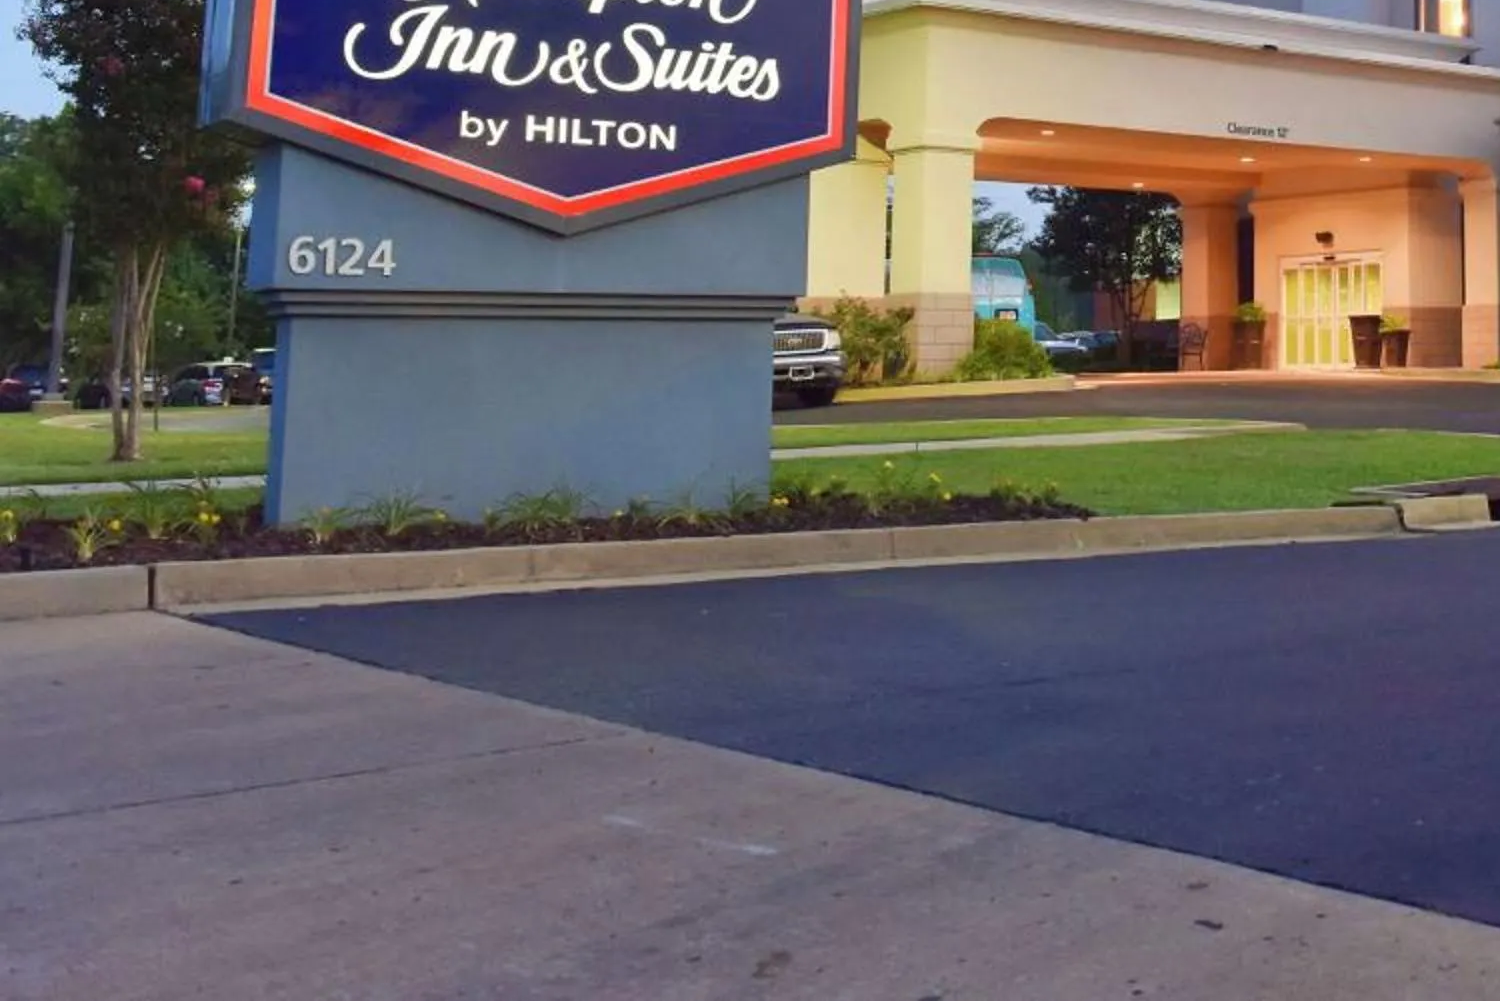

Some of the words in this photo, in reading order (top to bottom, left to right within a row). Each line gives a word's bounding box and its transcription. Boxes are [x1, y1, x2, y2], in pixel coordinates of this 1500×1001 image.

[344, 5, 550, 85] Inn
[549, 38, 598, 94] &
[594, 23, 780, 101] Suites
[459, 110, 507, 146] by
[525, 114, 677, 151] HILTON
[1227, 122, 1275, 138] Clearance
[288, 235, 396, 277] 6124
